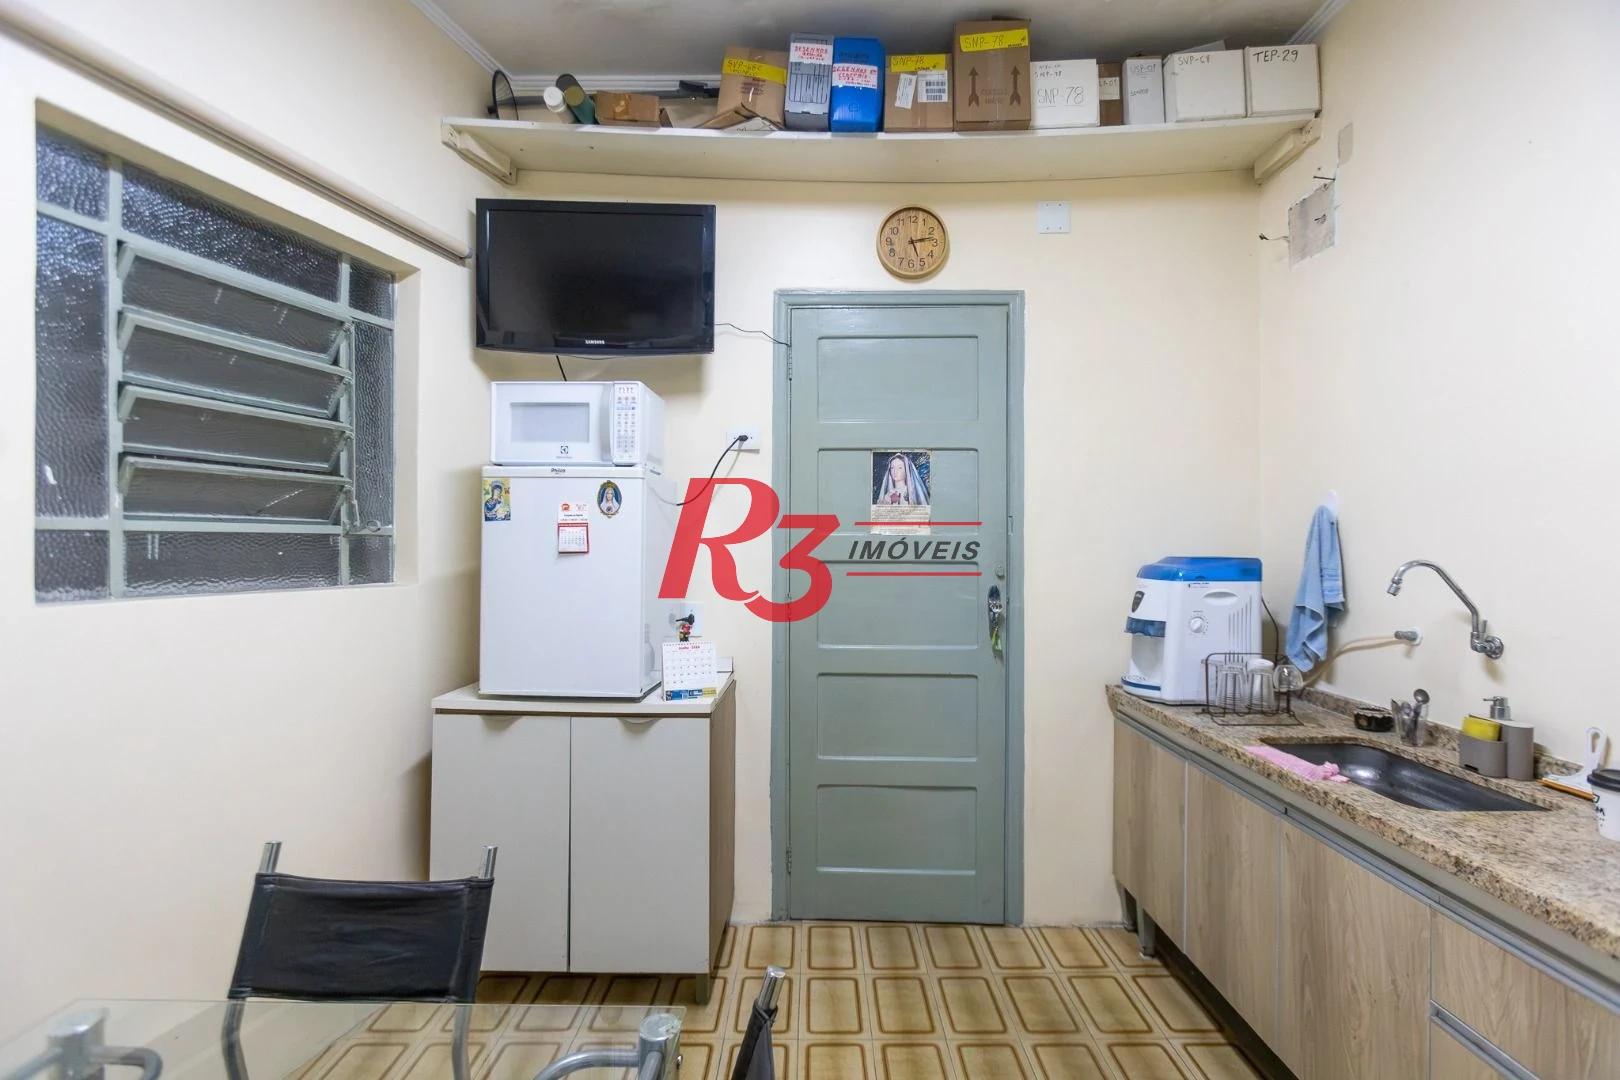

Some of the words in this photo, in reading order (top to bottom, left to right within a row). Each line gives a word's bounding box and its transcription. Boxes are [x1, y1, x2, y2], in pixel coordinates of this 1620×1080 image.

[1252, 49, 1299, 63] TEP-29
[897, 218, 904, 226] 11
[908, 216, 918, 224] 12
[922, 218, 926, 226] 1
[890, 226, 898, 235] 10
[928, 226, 934, 236] 2
[886, 236, 892, 246] 9
[932, 238, 938, 248] 3
[888, 248, 896, 257] 8
[928, 250, 934, 258] 4
[898, 257, 904, 266] 7
[908, 259, 914, 268] 6
[919, 258, 926, 266] 5
